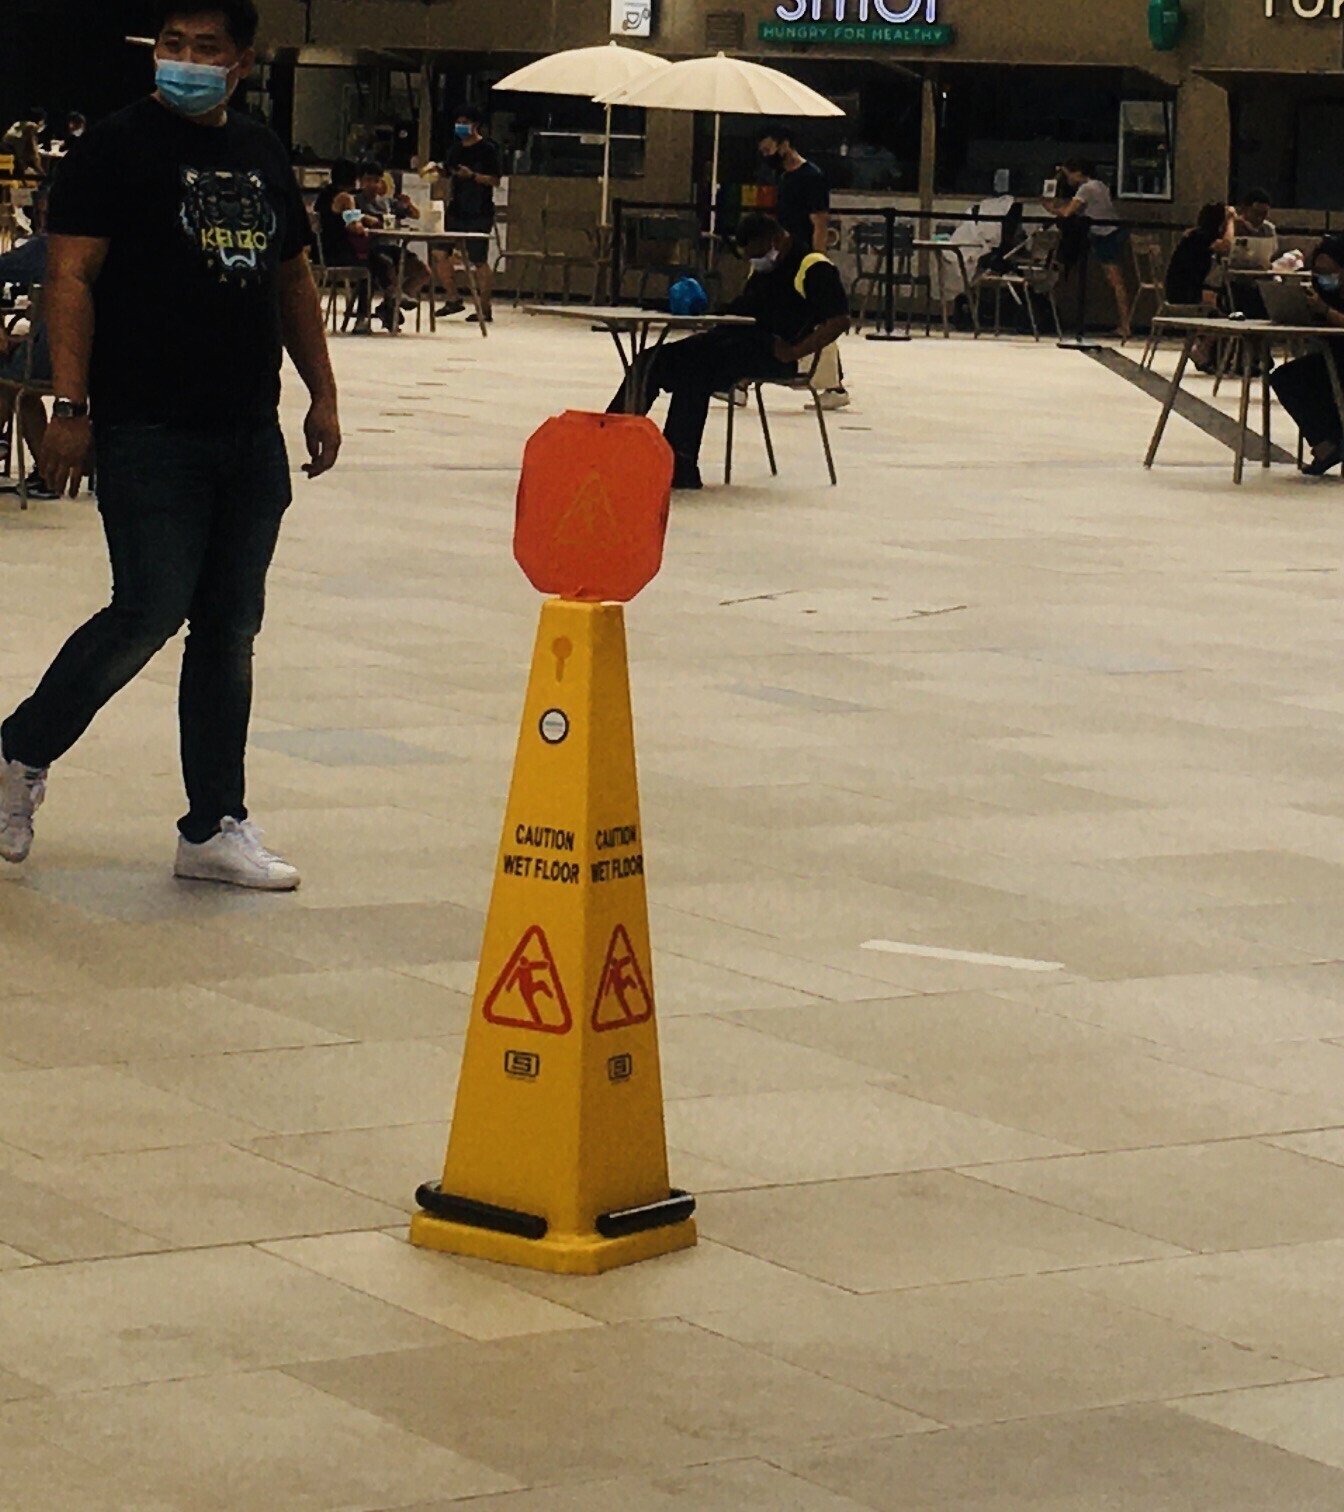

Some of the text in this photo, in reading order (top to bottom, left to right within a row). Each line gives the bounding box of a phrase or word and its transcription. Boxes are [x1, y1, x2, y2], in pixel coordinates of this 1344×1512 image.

[763, 24, 943, 41] HUNGRY FOR HEALTHY
[515, 823, 575, 851] CAUTION
[595, 825, 637, 851] CAUTION
[503, 853, 580, 884] WET FLOOR
[590, 854, 644, 883] WET FLOOR
